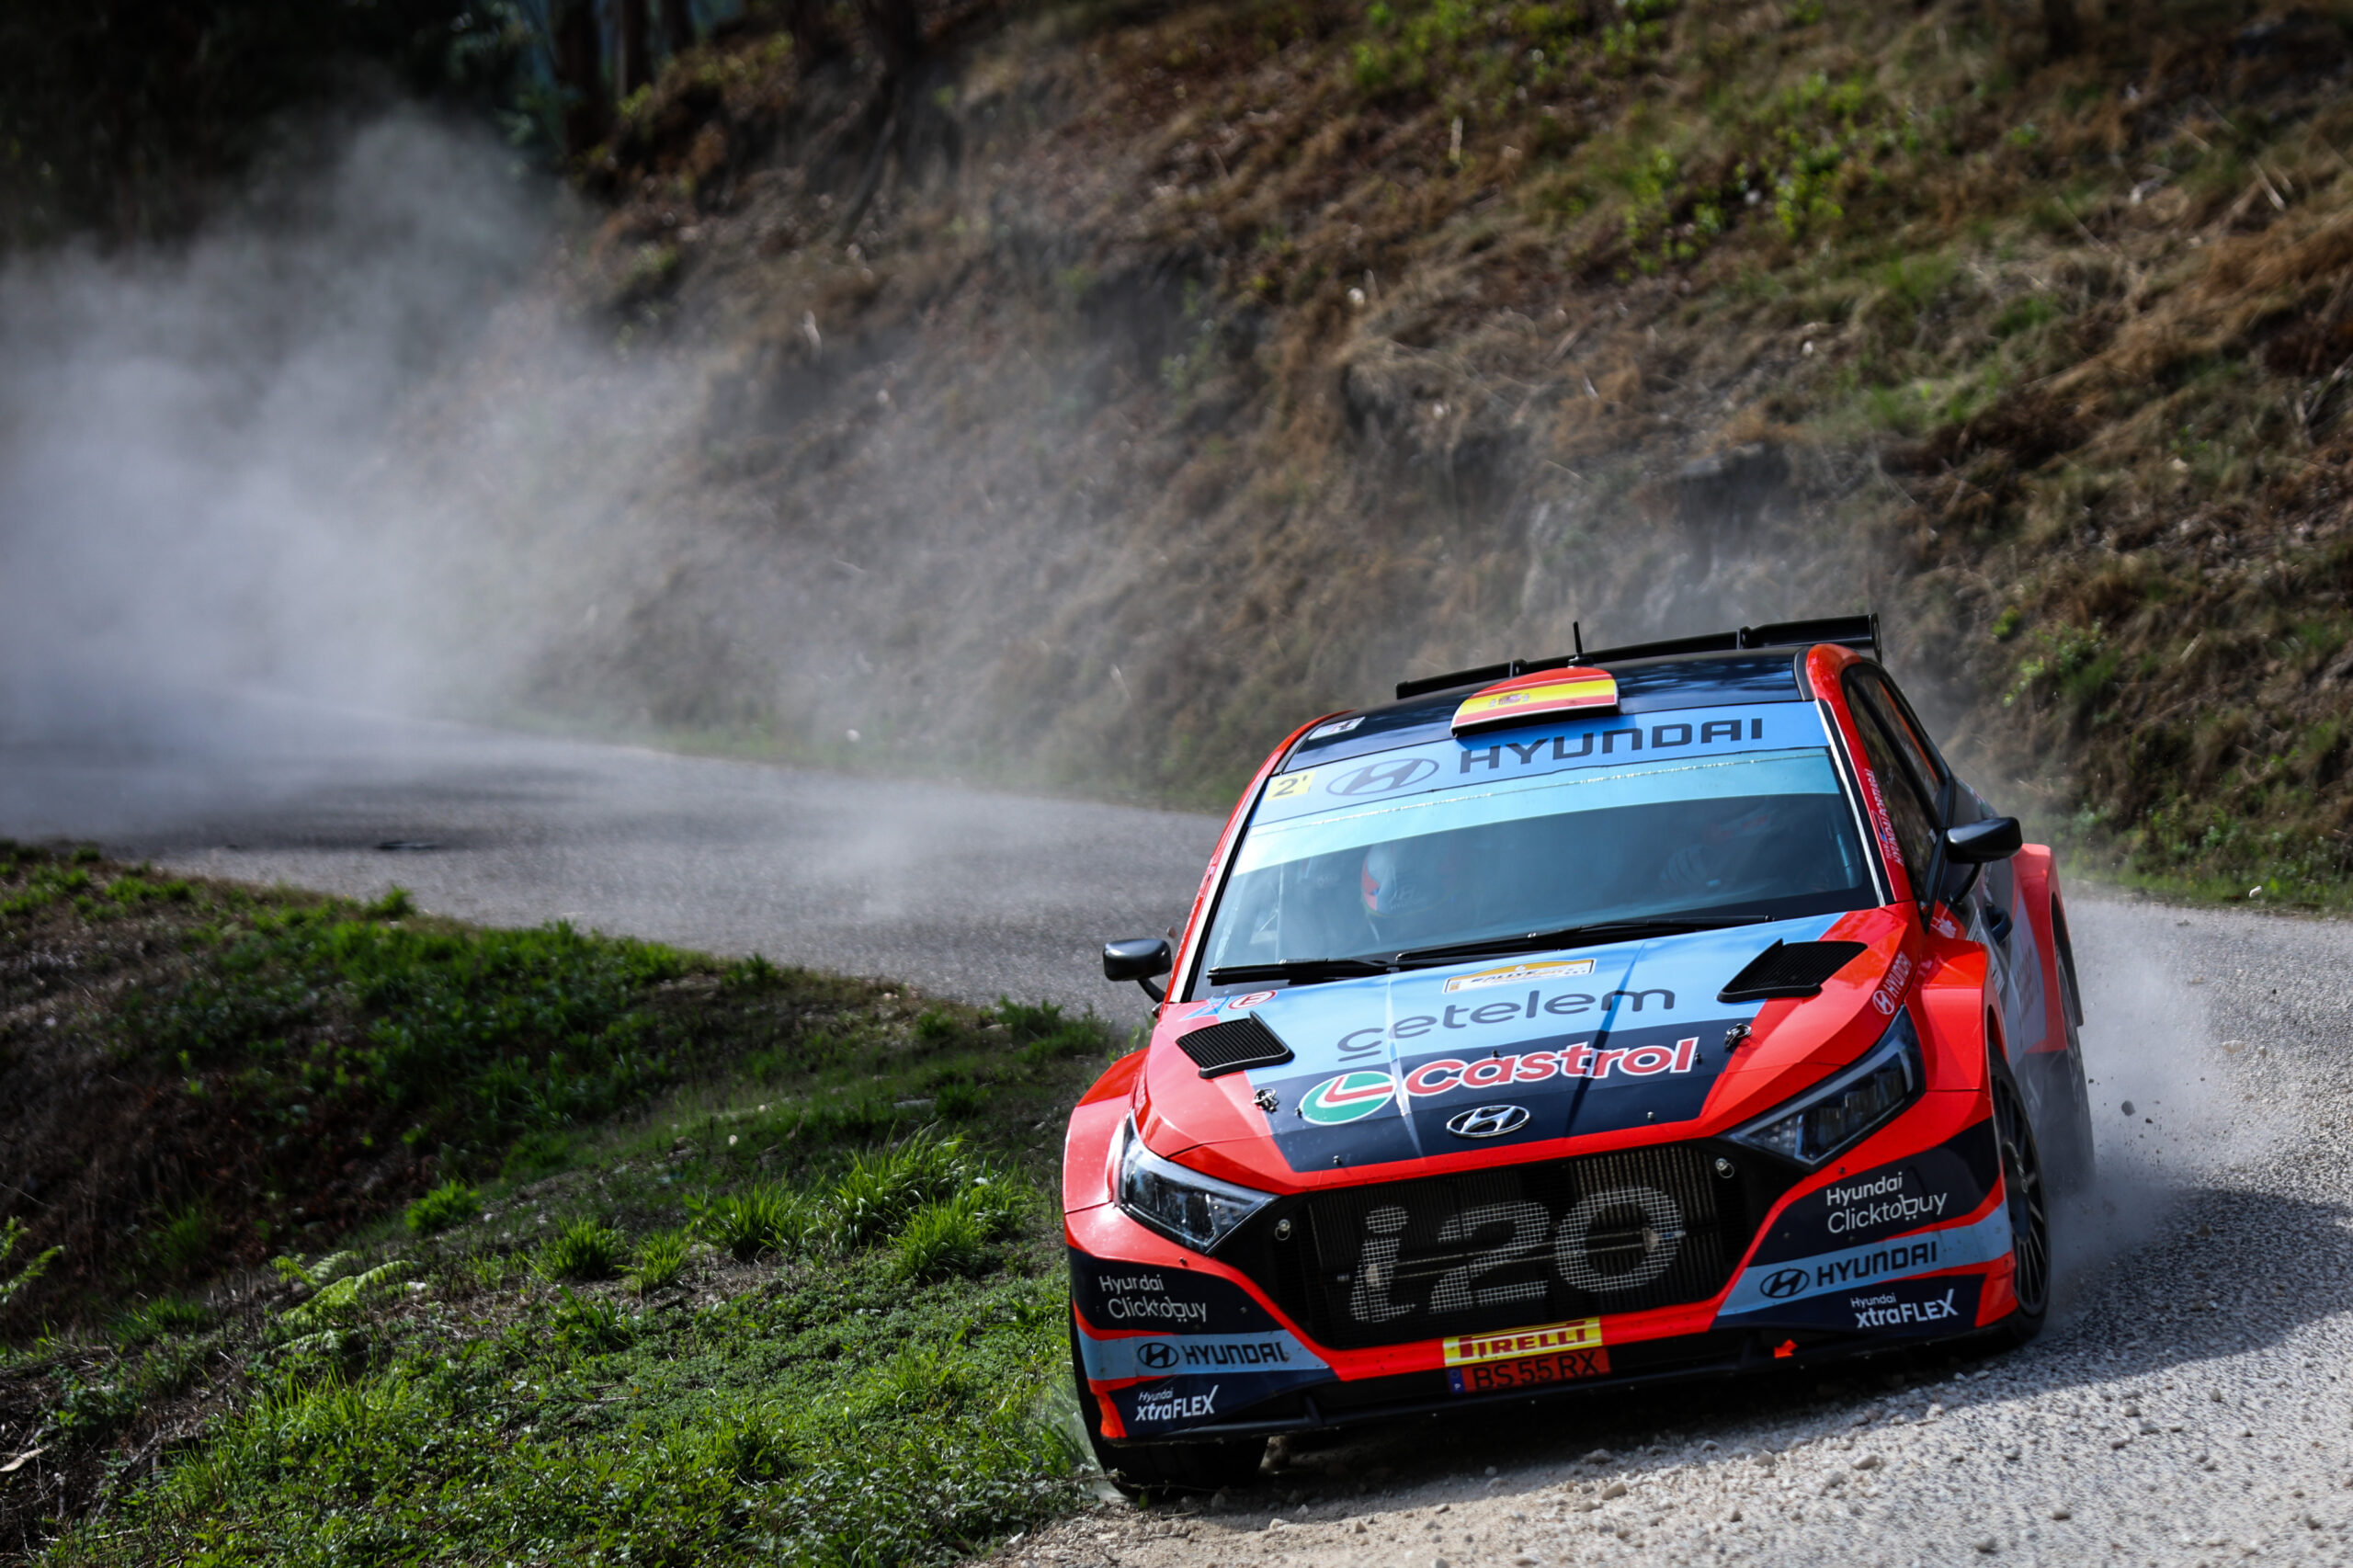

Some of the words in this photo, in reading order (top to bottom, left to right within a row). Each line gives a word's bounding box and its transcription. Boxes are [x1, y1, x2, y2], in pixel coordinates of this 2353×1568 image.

[1460, 718, 1763, 774] HYUNDAI
[1238, 993, 1267, 1006] E
[1337, 988, 1675, 1062] cetelem
[1405, 1036, 1699, 1097] Castrol
[1826, 1171, 1903, 1207] Hyundai
[1351, 1186, 1683, 1323] i20
[1816, 1241, 1937, 1288] HYUNDAI
[1849, 1292, 1897, 1308] Hyundai
[1855, 1288, 1959, 1329] xtraFLEX
[1181, 1341, 1289, 1366] HYUNDAI
[1459, 1320, 1586, 1359] PIRELLI
[1472, 1364, 1515, 1392] BS
[1517, 1356, 1553, 1384] 55
[1557, 1350, 1599, 1378] RX
[1134, 1384, 1220, 1422] xtraFLEX
[1138, 1388, 1175, 1403] Hyundai
